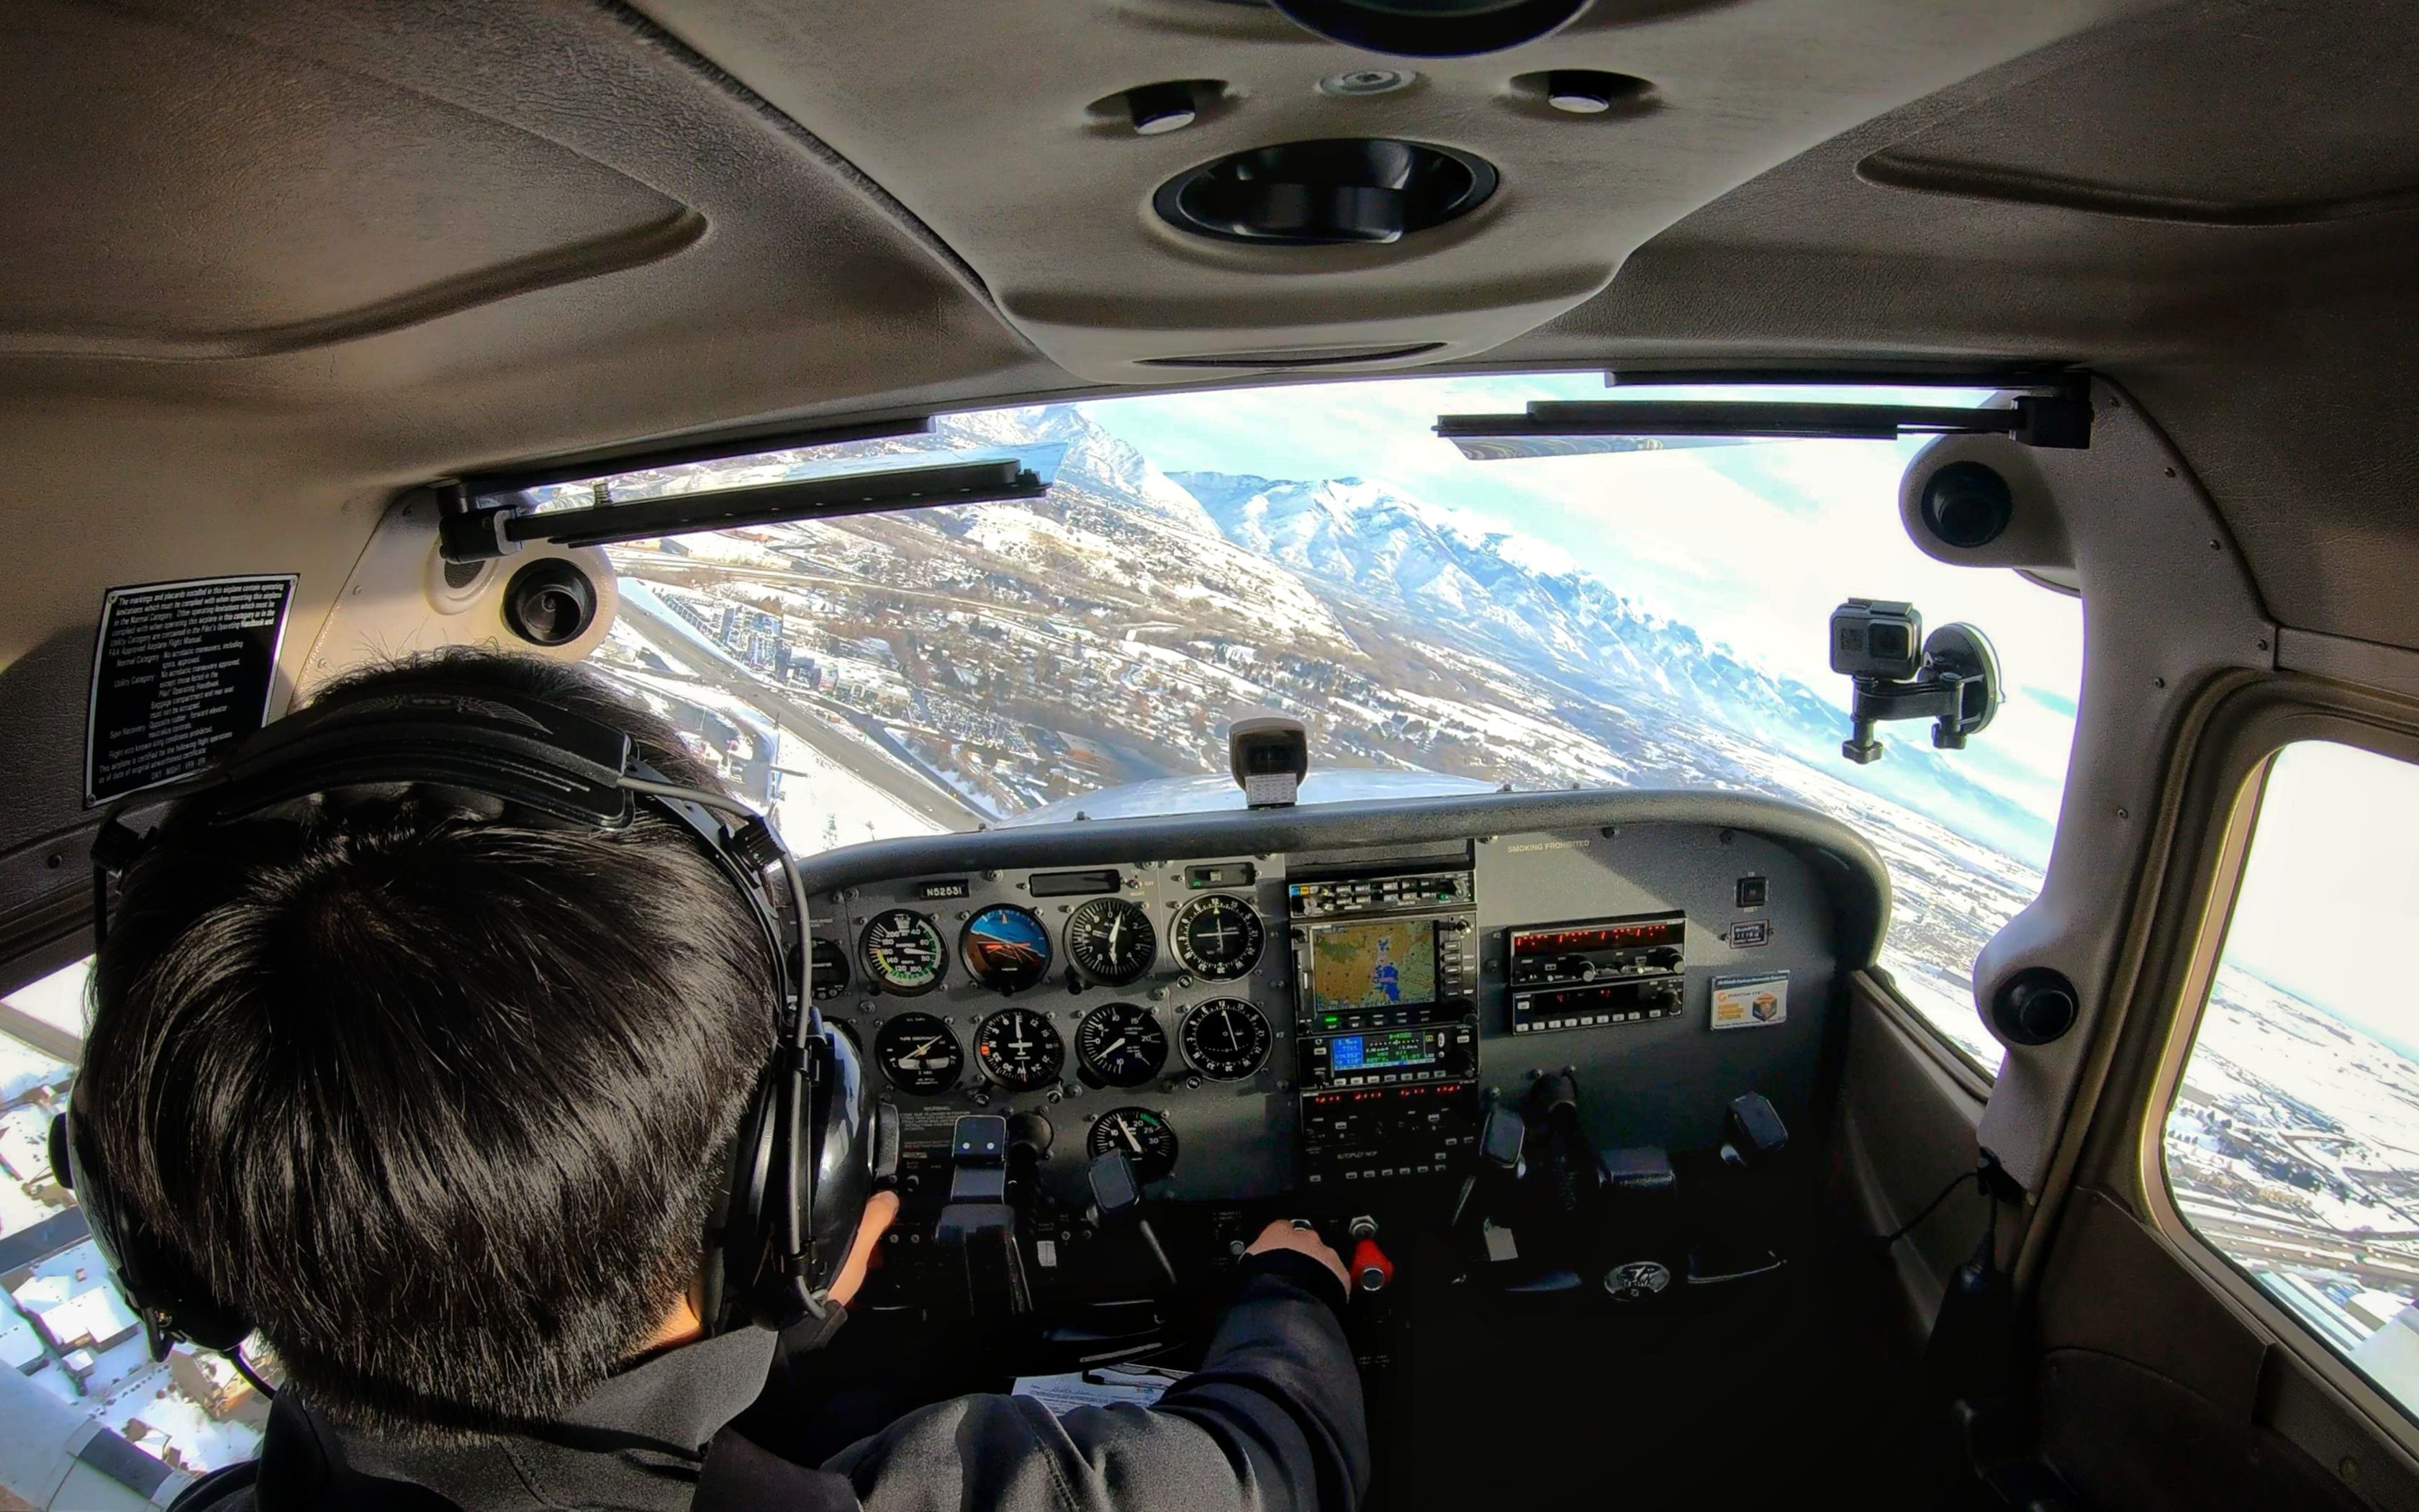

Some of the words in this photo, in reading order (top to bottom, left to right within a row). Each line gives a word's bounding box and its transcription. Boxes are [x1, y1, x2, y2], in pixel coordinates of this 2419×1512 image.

[1507, 843, 1543, 853] SMOKING
[1545, 840, 1590, 849] PROHIBITED
[1030, 1019, 1039, 1028] 12
